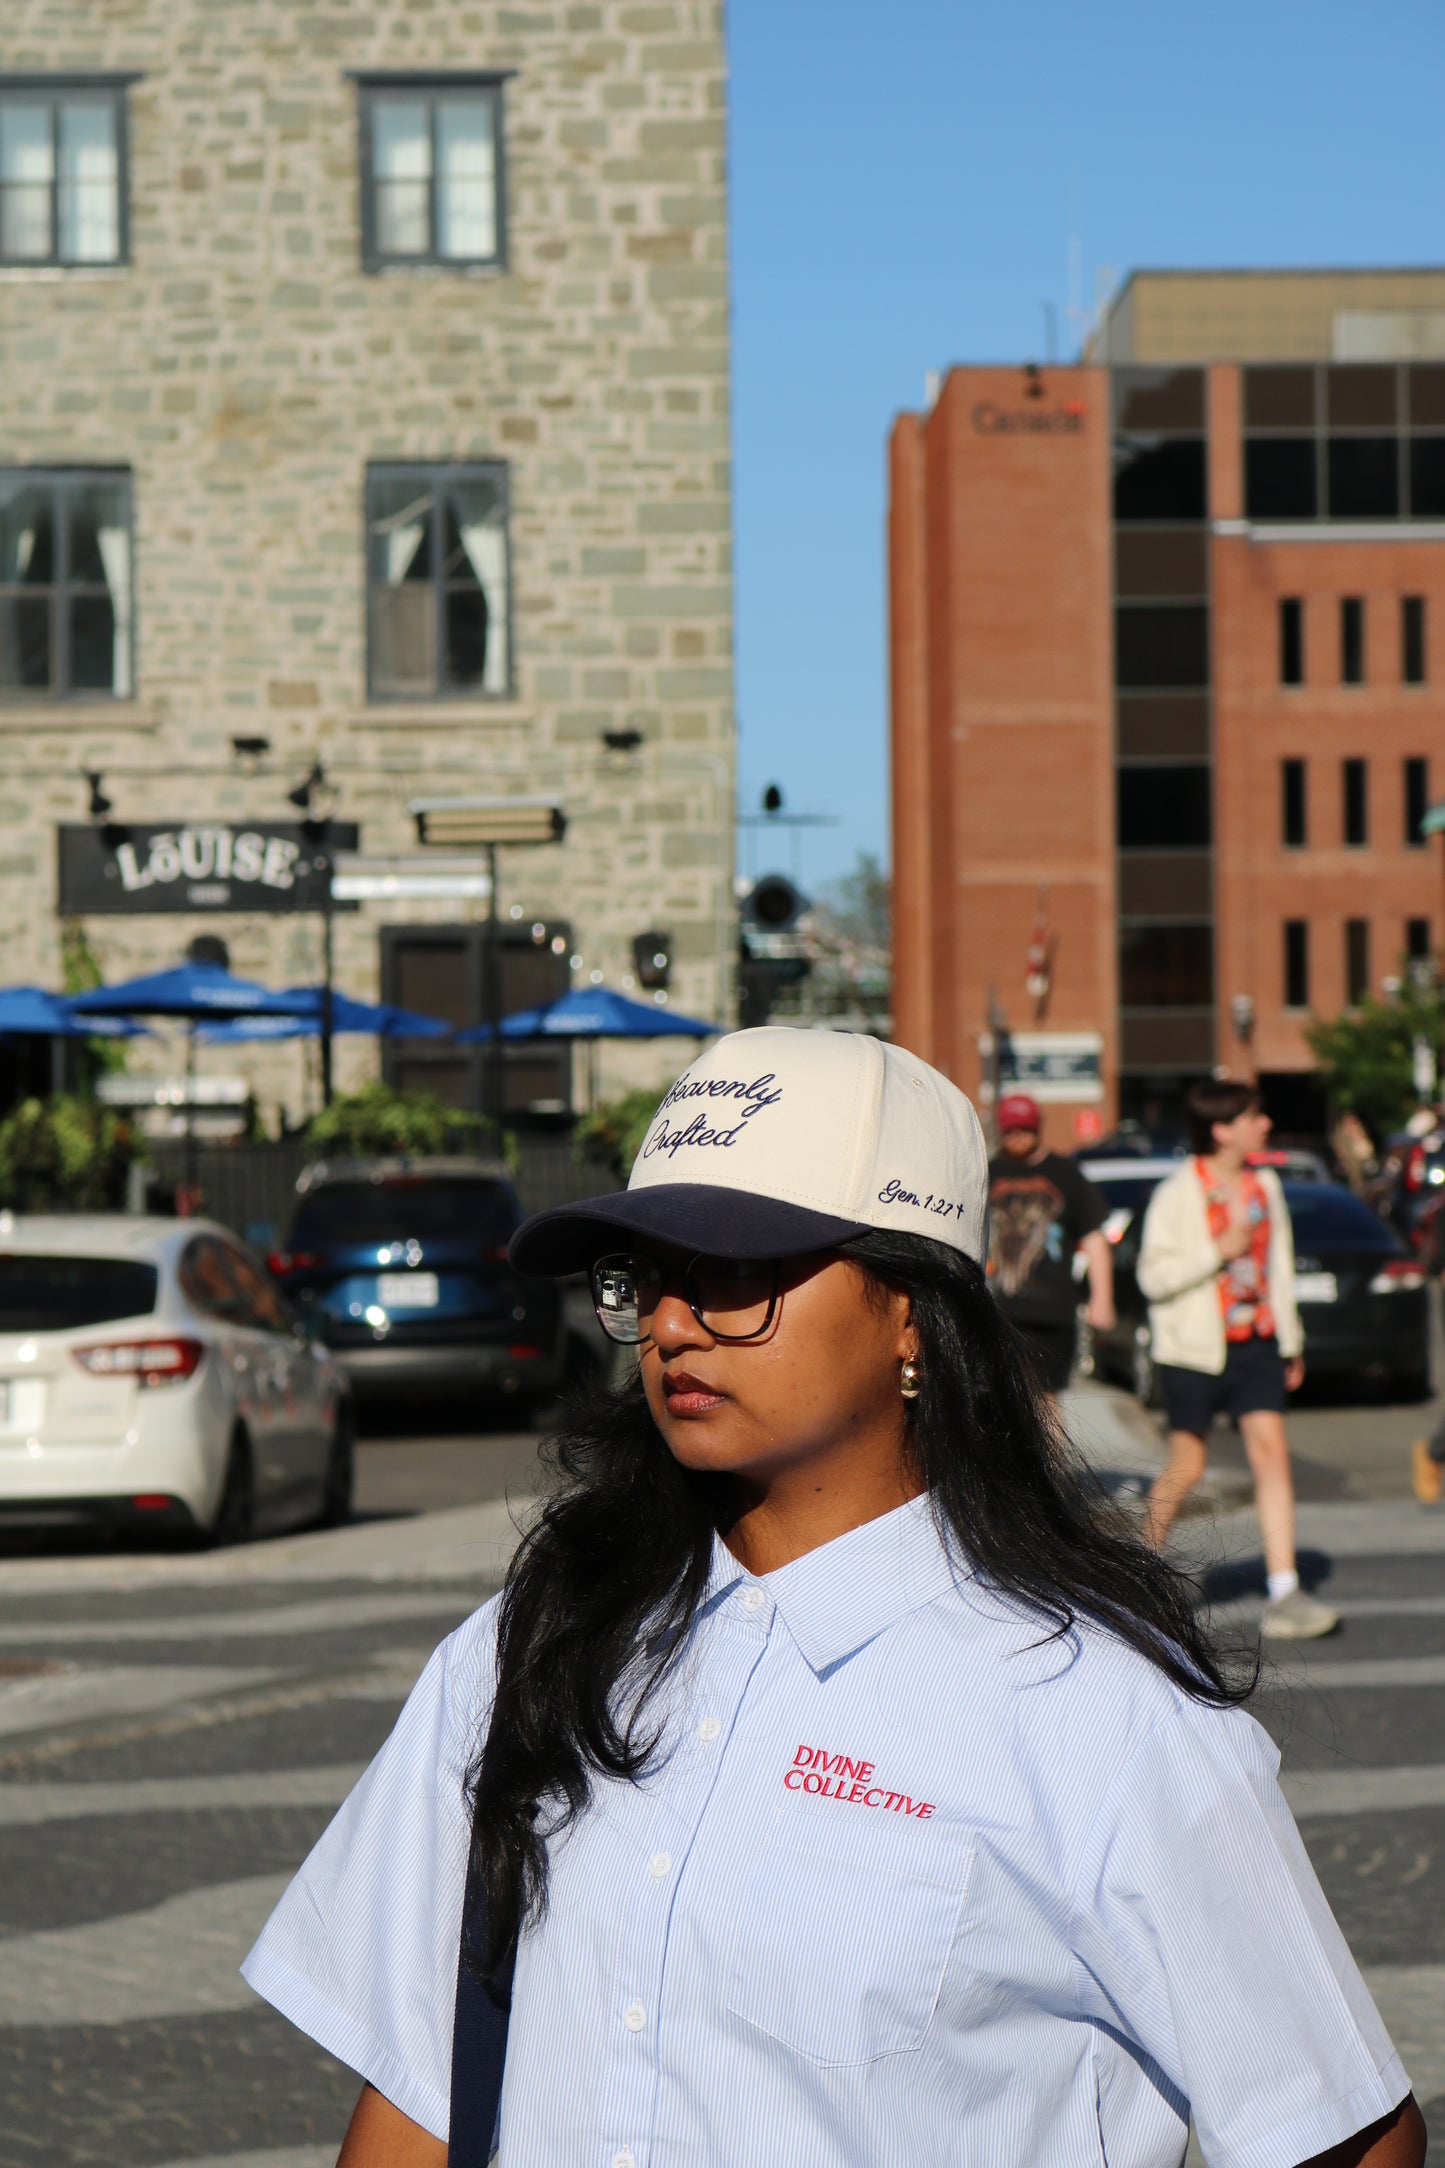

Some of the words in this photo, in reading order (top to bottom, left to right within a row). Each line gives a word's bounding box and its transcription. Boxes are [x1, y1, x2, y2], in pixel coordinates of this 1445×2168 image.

[654, 1072, 783, 1118] Heavenly
[643, 1112, 749, 1159] Crafted
[878, 1179, 920, 1207] Gen.
[793, 1744, 876, 1783] DIVINE
[783, 1769, 936, 1819] COLLECTIVE
